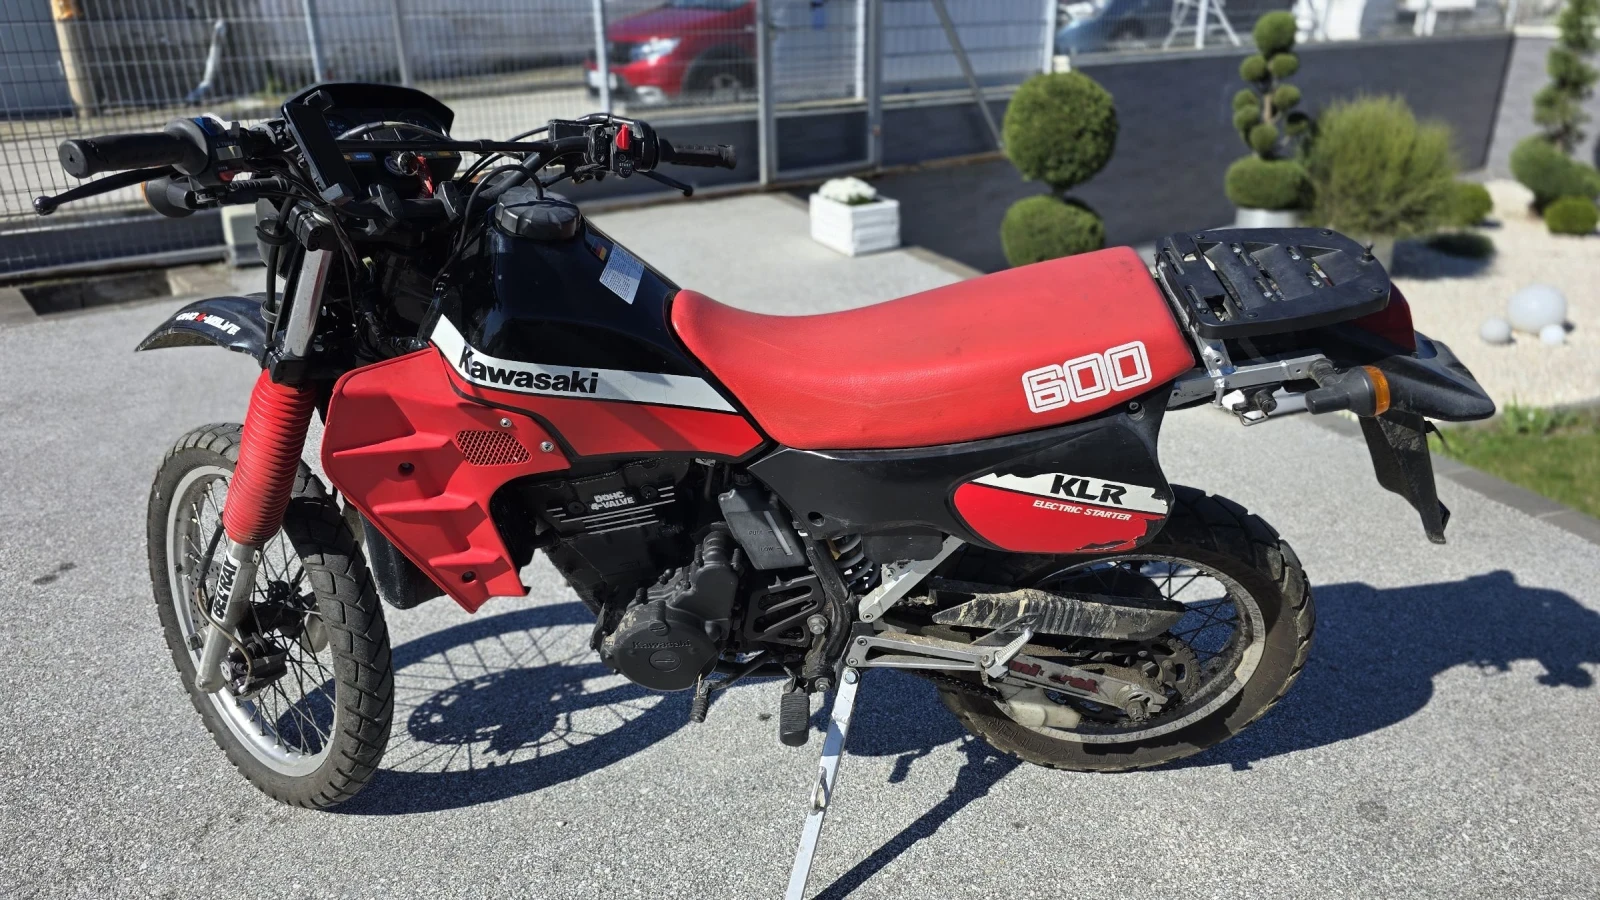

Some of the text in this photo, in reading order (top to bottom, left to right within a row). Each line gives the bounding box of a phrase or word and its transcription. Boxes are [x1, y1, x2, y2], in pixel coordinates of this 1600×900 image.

[458, 345, 599, 394] Kawasaki
[1022, 340, 1153, 414] 600
[1050, 474, 1127, 505] KLR
[1033, 500, 1132, 521] ELECTRIC STARTER
